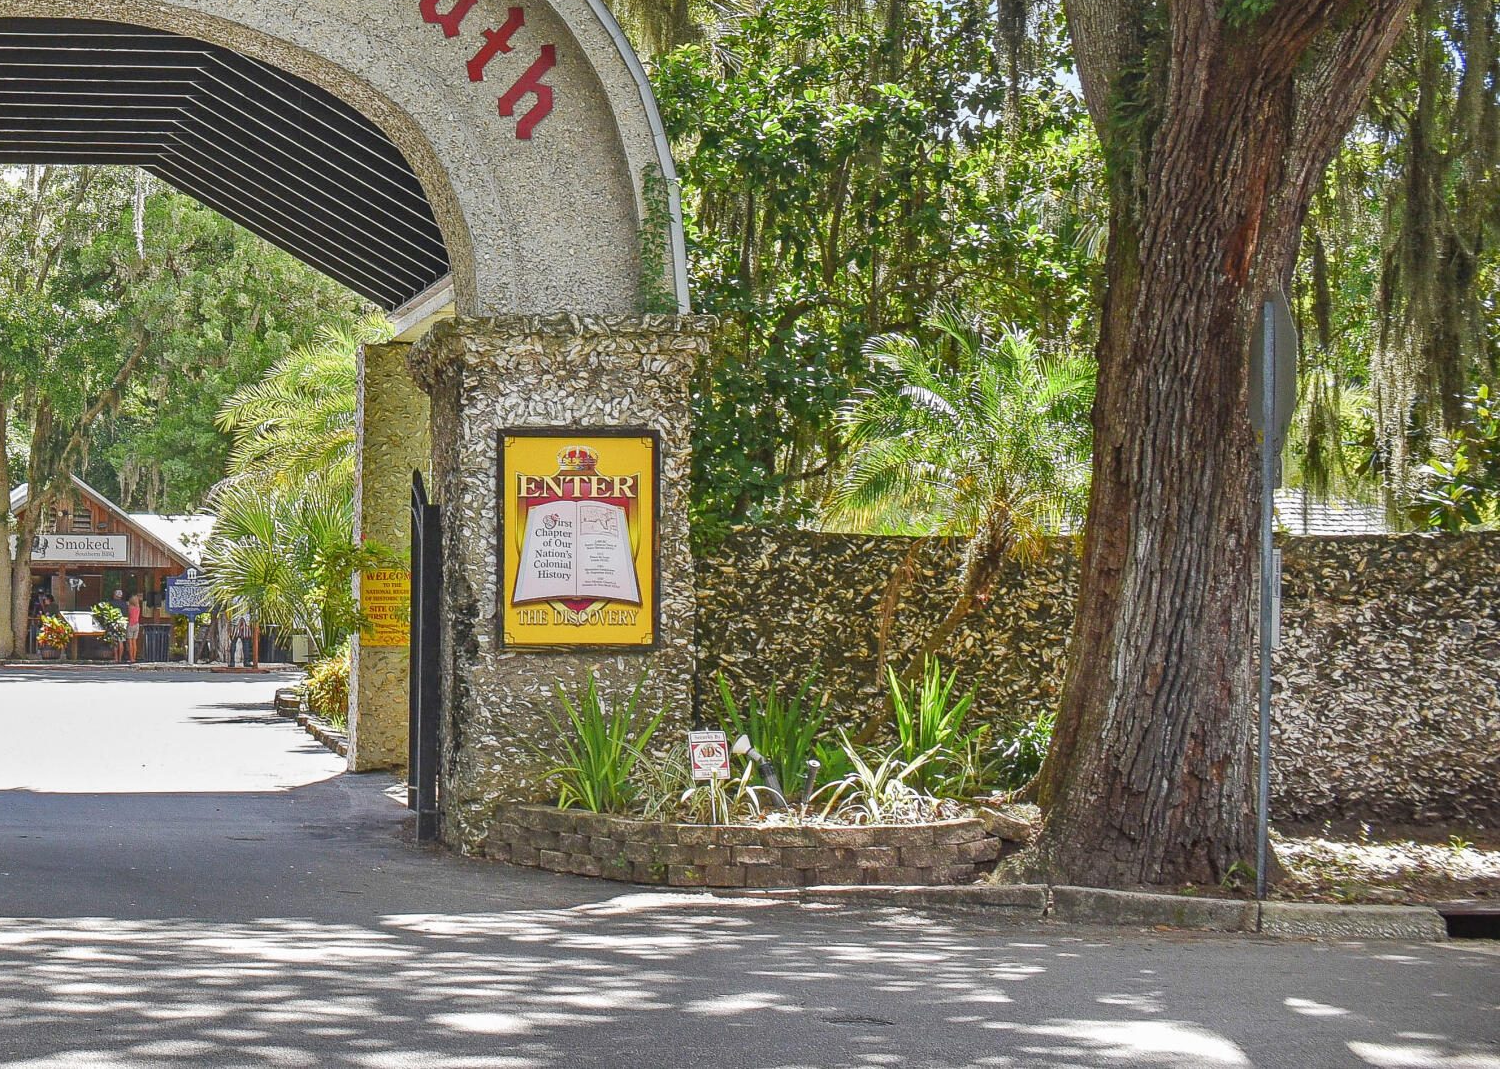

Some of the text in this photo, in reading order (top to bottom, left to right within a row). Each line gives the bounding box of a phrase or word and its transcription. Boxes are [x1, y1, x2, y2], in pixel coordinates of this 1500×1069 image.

[517, 474, 637, 498] ENTER
[535, 528, 572, 538] Chapter
[55, 537, 114, 550] Smoked.
[543, 539, 572, 548] of Our
[535, 550, 572, 559] Nation's
[533, 559, 572, 569] Colonial
[366, 572, 412, 580] WELCOM
[538, 570, 571, 581] History
[517, 609, 639, 626] THE DISCOVERY
[698, 746, 722, 758] ADS
